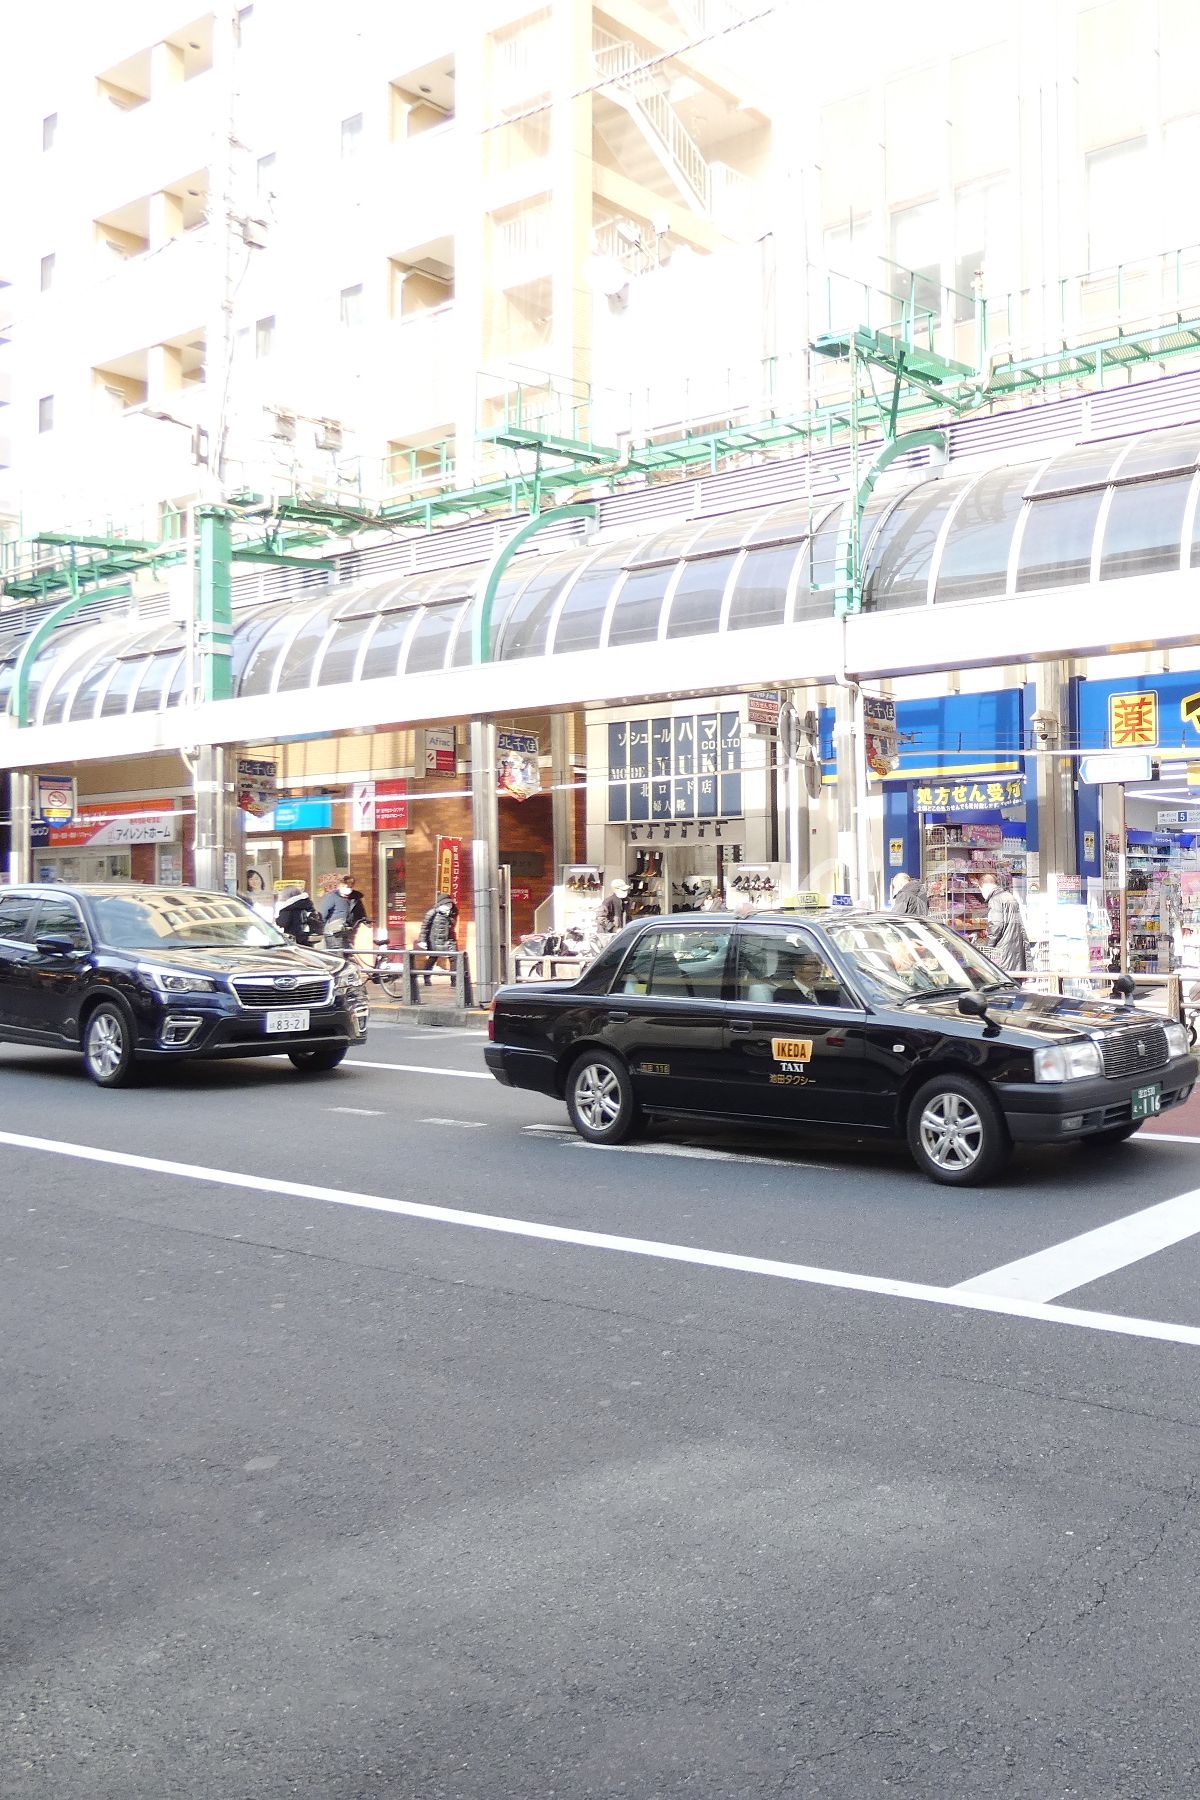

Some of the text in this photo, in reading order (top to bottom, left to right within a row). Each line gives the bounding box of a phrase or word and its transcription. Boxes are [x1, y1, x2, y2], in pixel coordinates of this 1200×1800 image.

[1113, 696, 1153, 744] 薬
[500, 735, 538, 753] 北千住
[656, 752, 735, 776] YUKI
[917, 782, 1021, 805] 処方せん受付
[116, 825, 171, 841] アイレントホーム
[277, 1018, 306, 1031] 83-21
[777, 1042, 807, 1059] IKEDA
[780, 1062, 804, 1073] TAXI
[769, 1074, 816, 1085] 池田タクシー
